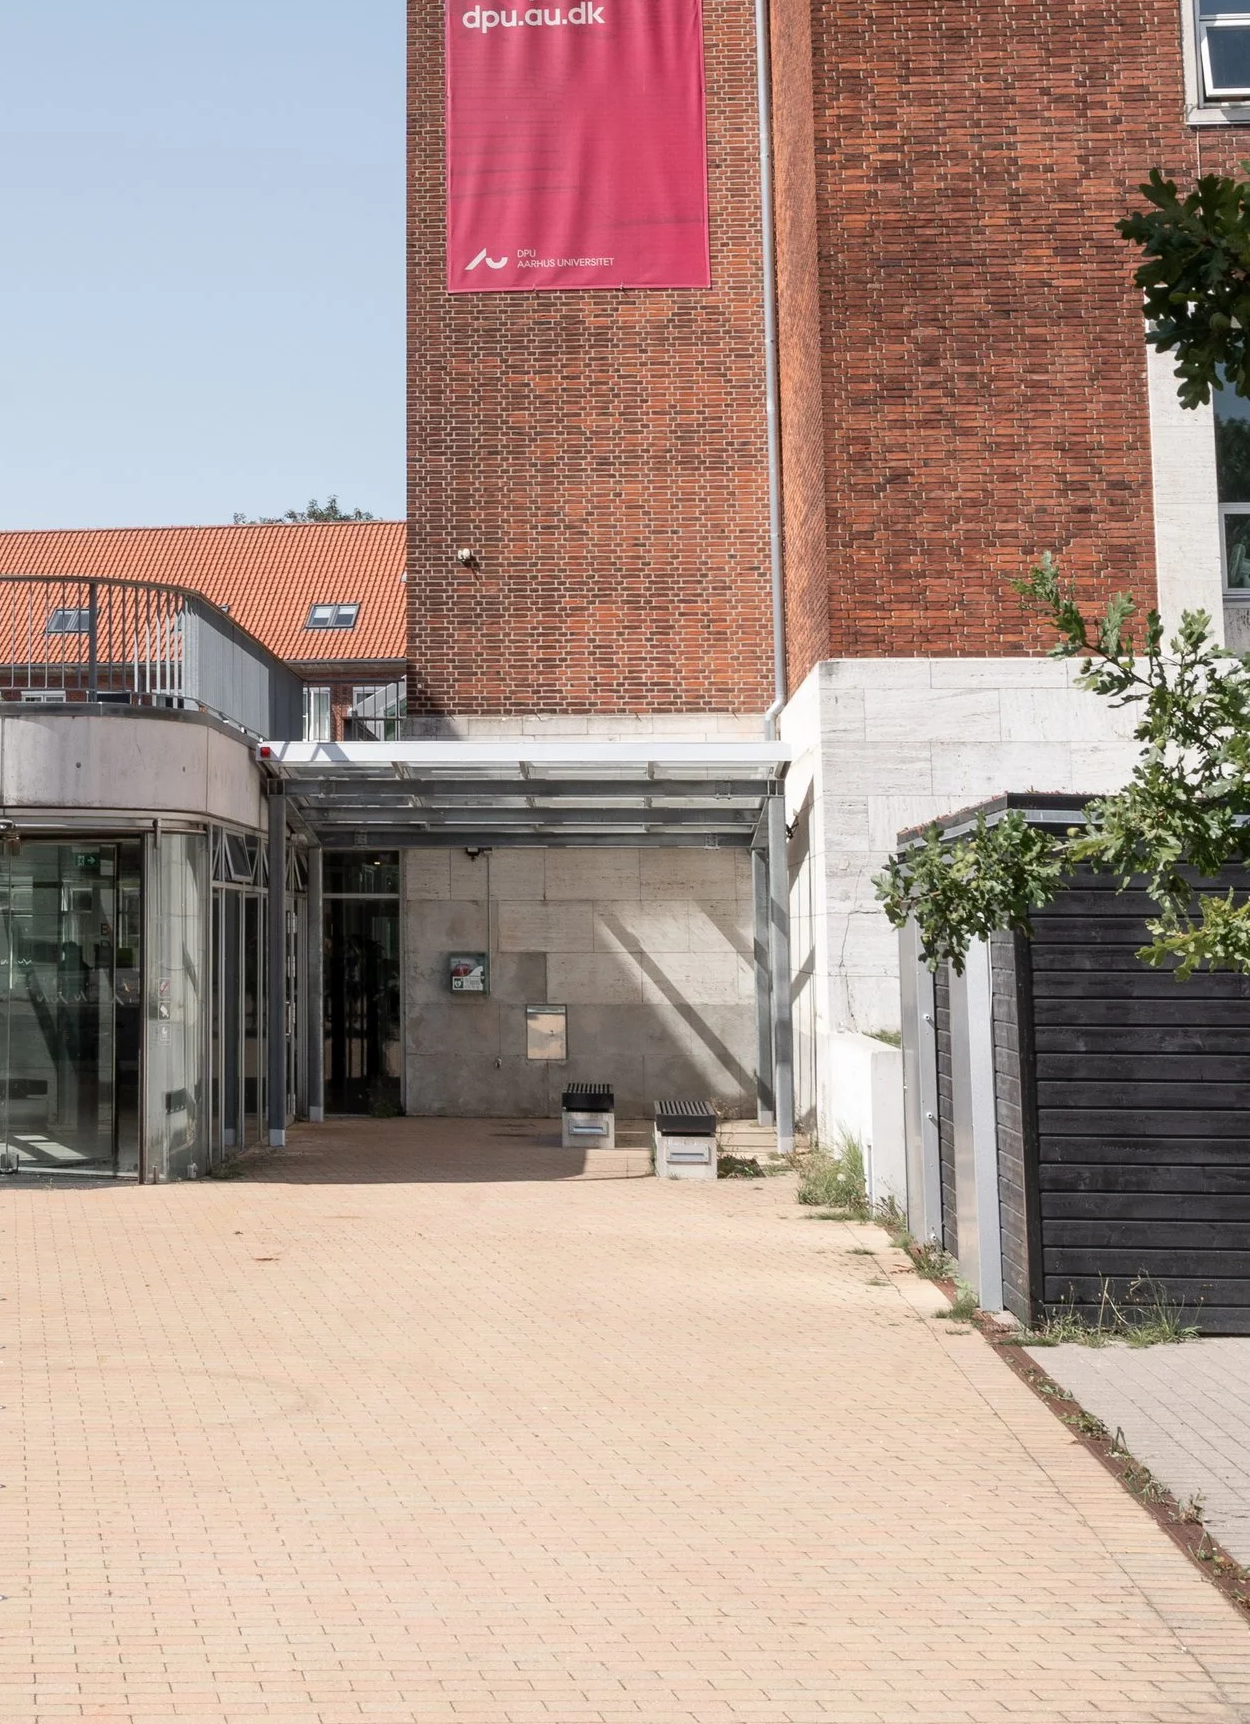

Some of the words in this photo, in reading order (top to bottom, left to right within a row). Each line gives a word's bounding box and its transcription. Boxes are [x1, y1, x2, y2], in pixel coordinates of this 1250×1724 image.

[461, 1, 605, 34] dpu.au.dk
[517, 249, 536, 258] DPU
[517, 258, 556, 269] AARHUS
[557, 257, 615, 268] UNIVERSITET
